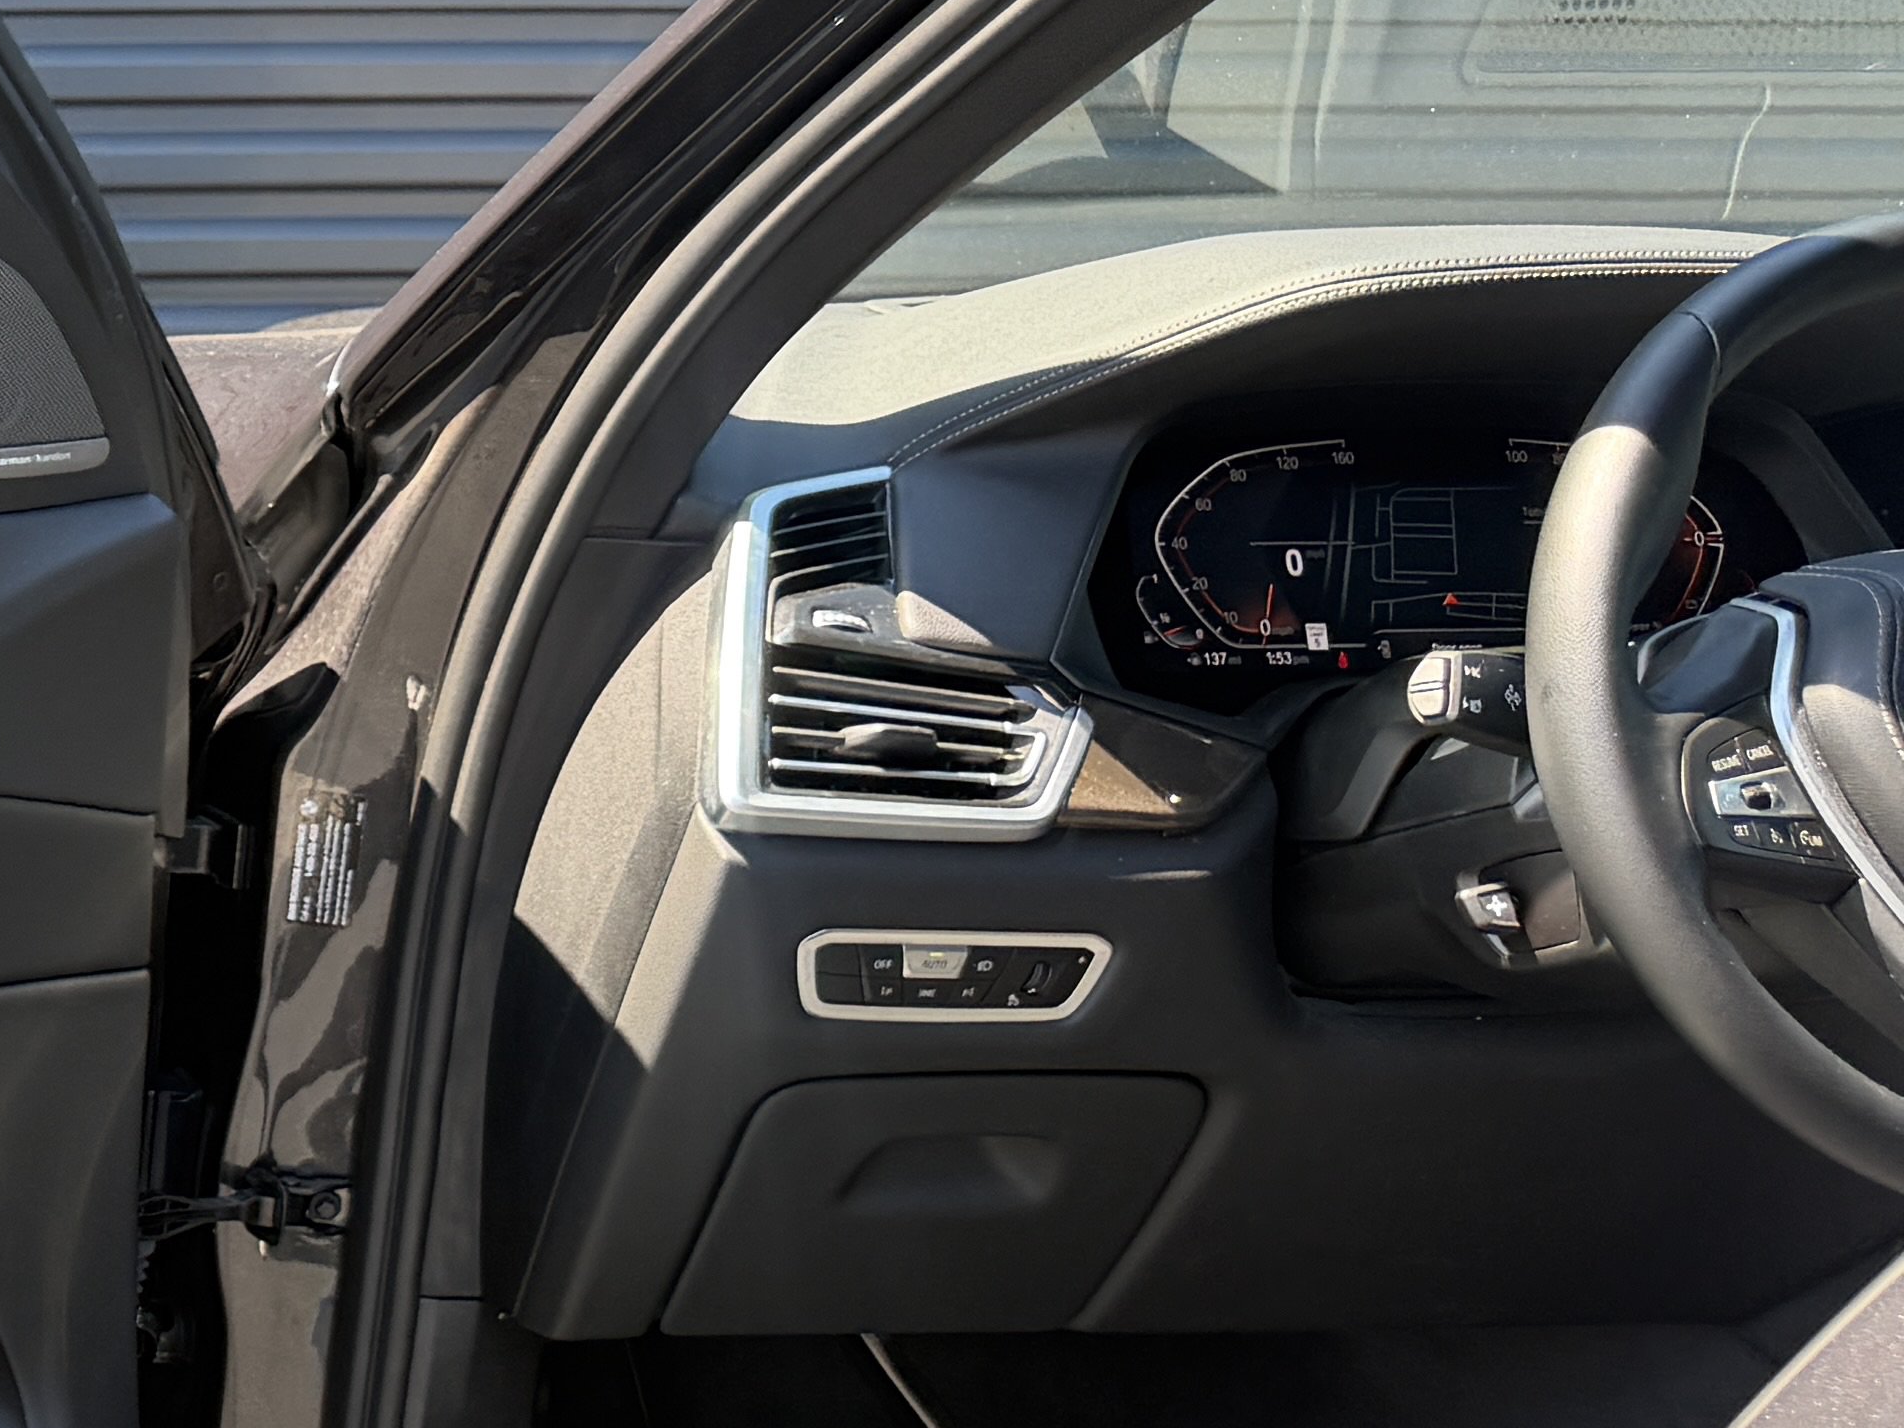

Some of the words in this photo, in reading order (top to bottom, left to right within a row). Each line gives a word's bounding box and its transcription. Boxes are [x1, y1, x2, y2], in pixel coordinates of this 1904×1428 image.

[1276, 456, 1299, 470] 120
[1331, 451, 1355, 465] 160
[1505, 450, 1528, 464] 100
[1229, 469, 1247, 482] 80
[1194, 498, 1212, 512] 60
[1171, 537, 1188, 550] 40
[1695, 530, 1704, 547] 0
[1285, 548, 1304, 577] 0
[1191, 576, 1209, 590] 20
[1223, 611, 1239, 624] 10
[1260, 618, 1271, 637] 0
[1204, 651, 1227, 666] 137
[1266, 651, 1293, 666] 1:53
[873, 959, 893, 970] OFF
